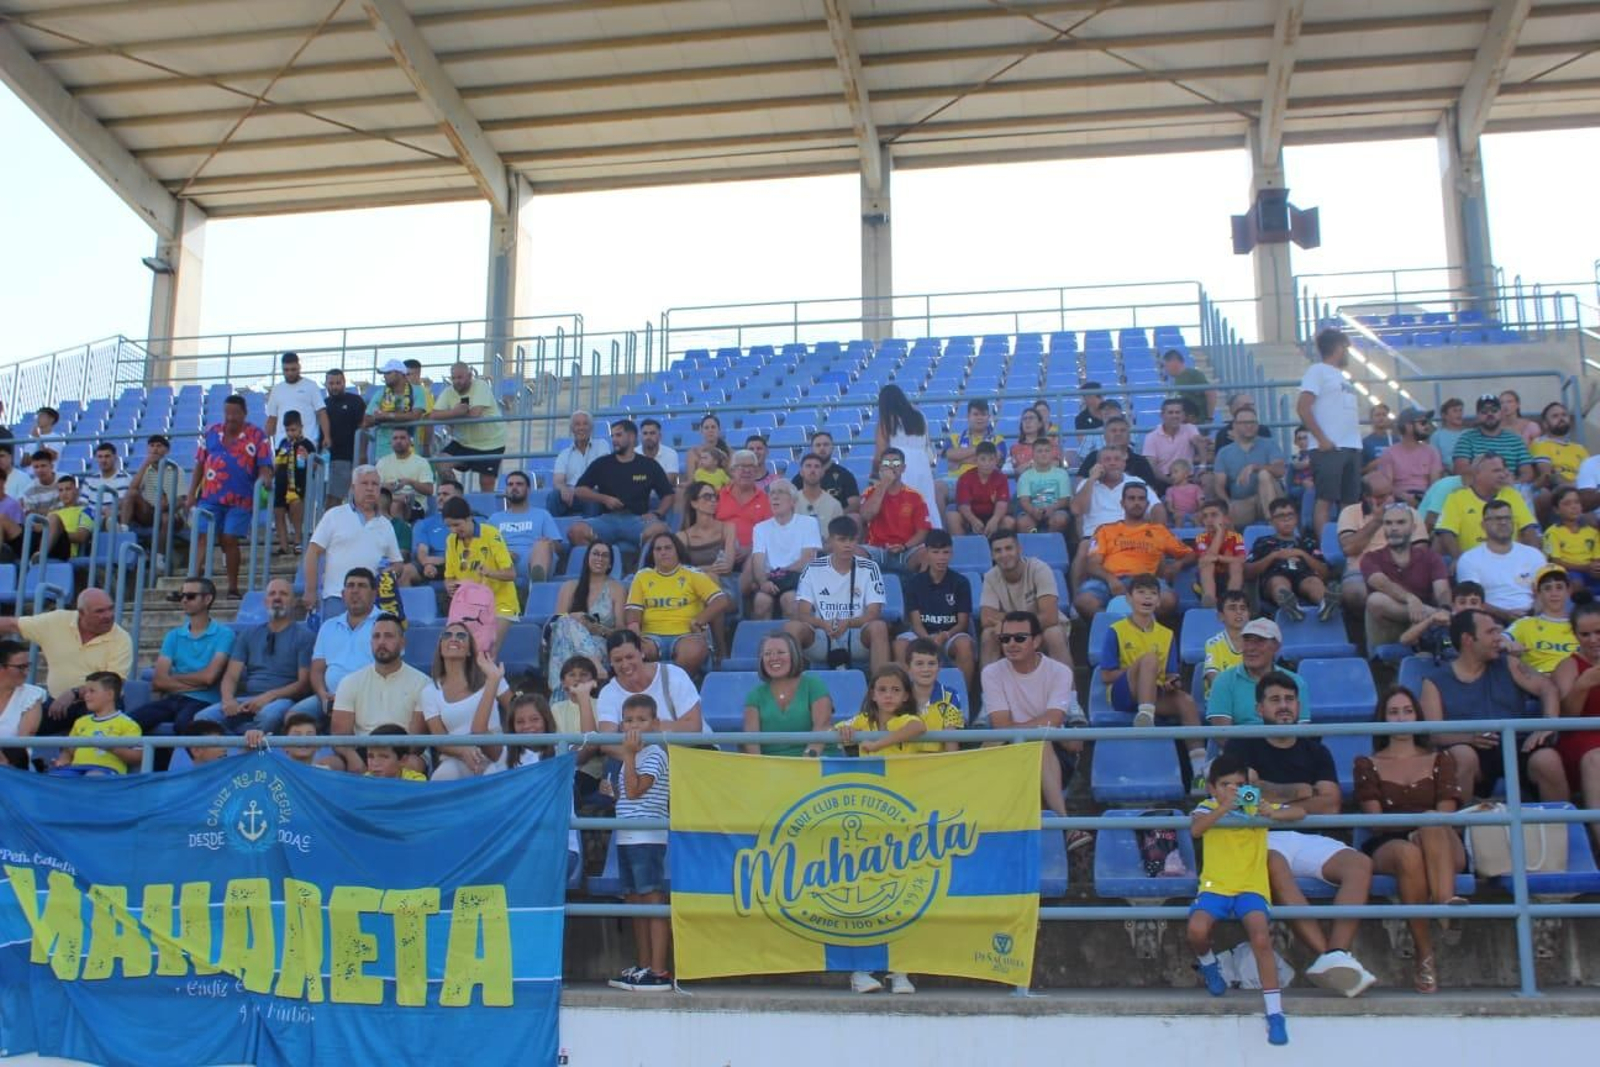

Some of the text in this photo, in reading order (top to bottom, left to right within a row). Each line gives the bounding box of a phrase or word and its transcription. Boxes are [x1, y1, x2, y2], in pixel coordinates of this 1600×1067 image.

[812, 797, 839, 815] CLUB
[843, 795, 857, 807] DE
[188, 831, 226, 850] DESDE
[740, 809, 978, 910] Mahareta
